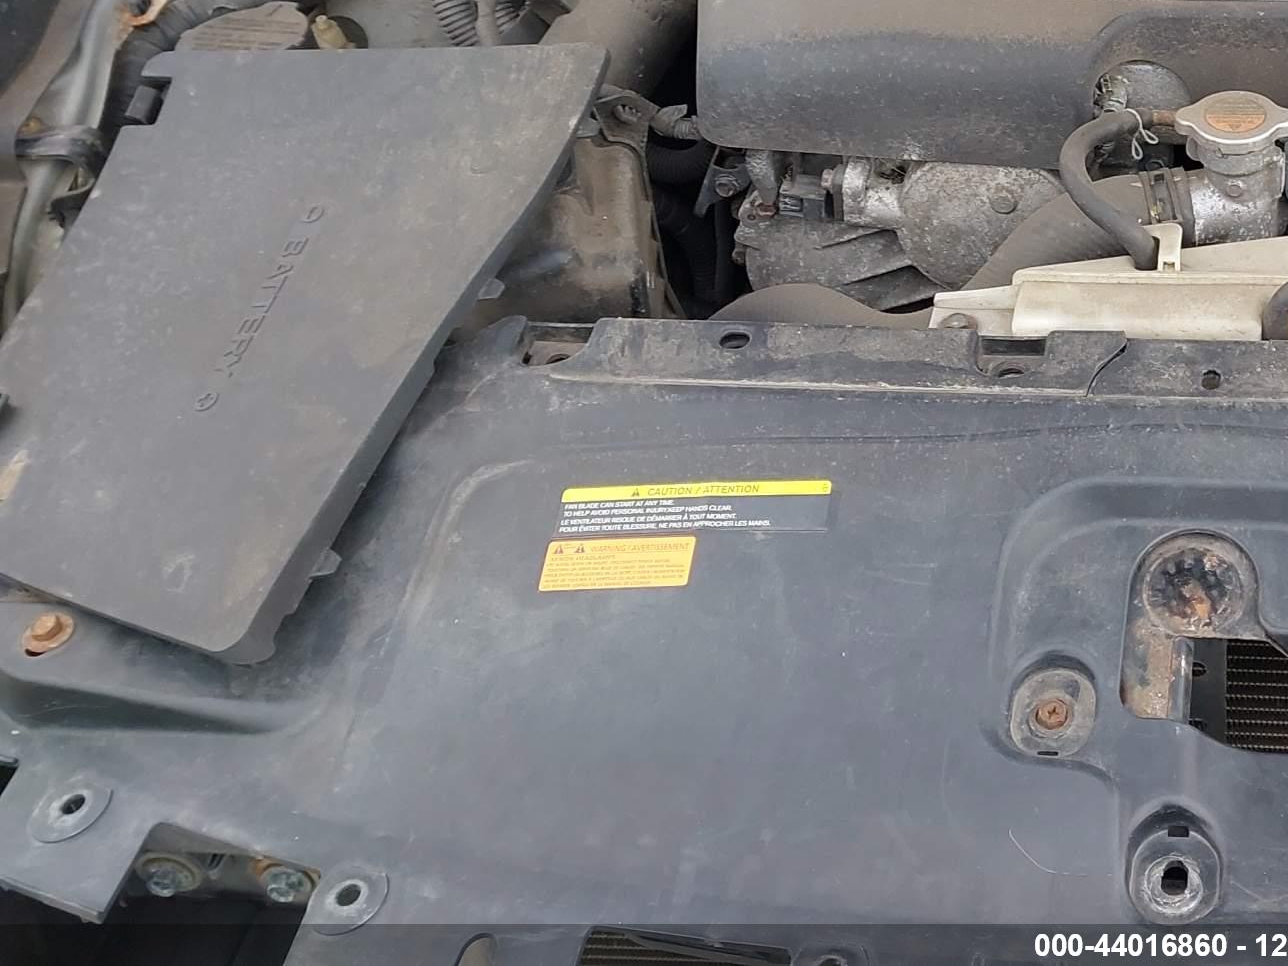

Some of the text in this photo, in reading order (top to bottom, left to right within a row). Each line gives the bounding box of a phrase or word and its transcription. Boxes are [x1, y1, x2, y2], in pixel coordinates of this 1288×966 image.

[213, 237, 310, 379] BATTERY
[647, 487, 691, 497] CAUTION
[703, 484, 760, 494] ATTENTION
[600, 501, 614, 509] CAN
[563, 510, 573, 518] TO
[573, 509, 590, 517] HELP
[611, 507, 645, 515] PERSONAL
[570, 517, 611, 525] VENTILATEUR
[669, 521, 682, 529] PAS
[591, 544, 627, 553] WARNING
